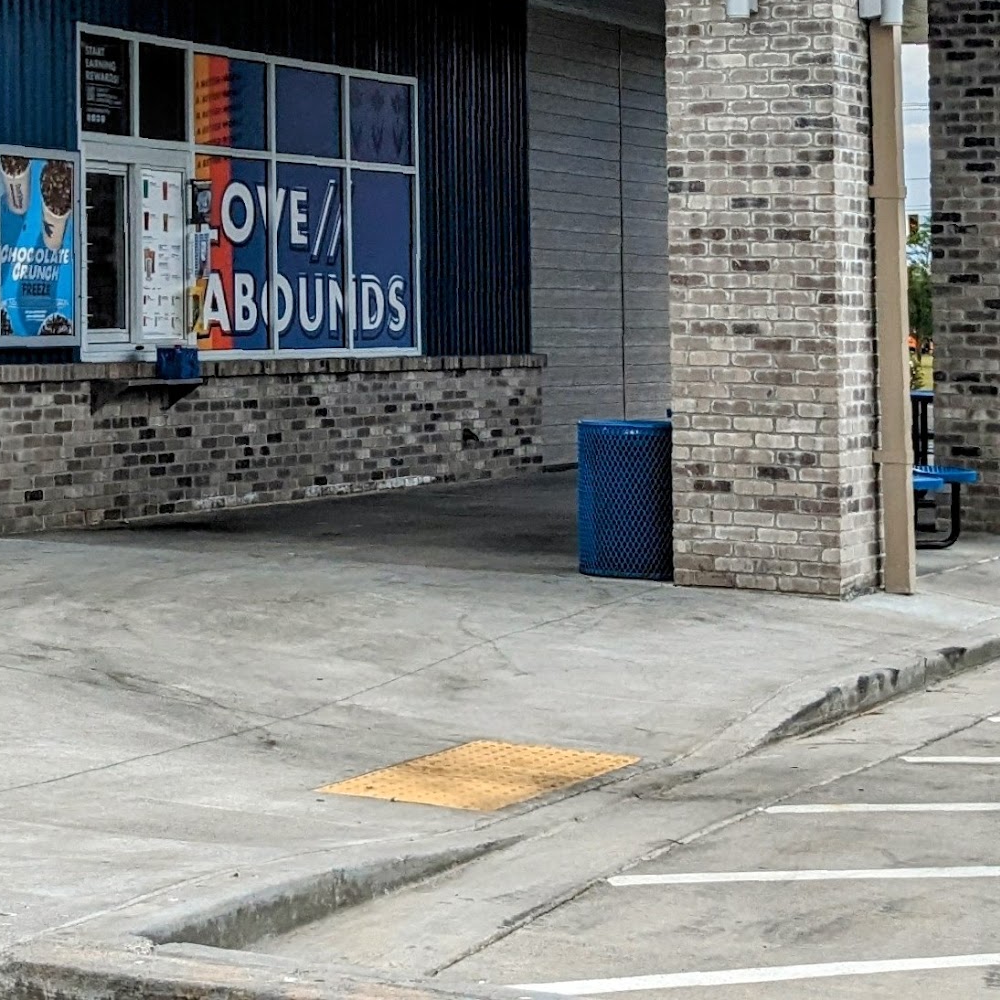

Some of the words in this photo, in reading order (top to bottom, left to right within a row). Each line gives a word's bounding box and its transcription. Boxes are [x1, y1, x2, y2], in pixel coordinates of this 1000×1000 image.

[209, 181, 309, 245] OVE
[0, 244, 70, 264] CHOCOLATE
[12, 262, 60, 281] CRUNCH
[21, 282, 51, 296] FREEZE
[203, 272, 407, 333] ABOUNDS
